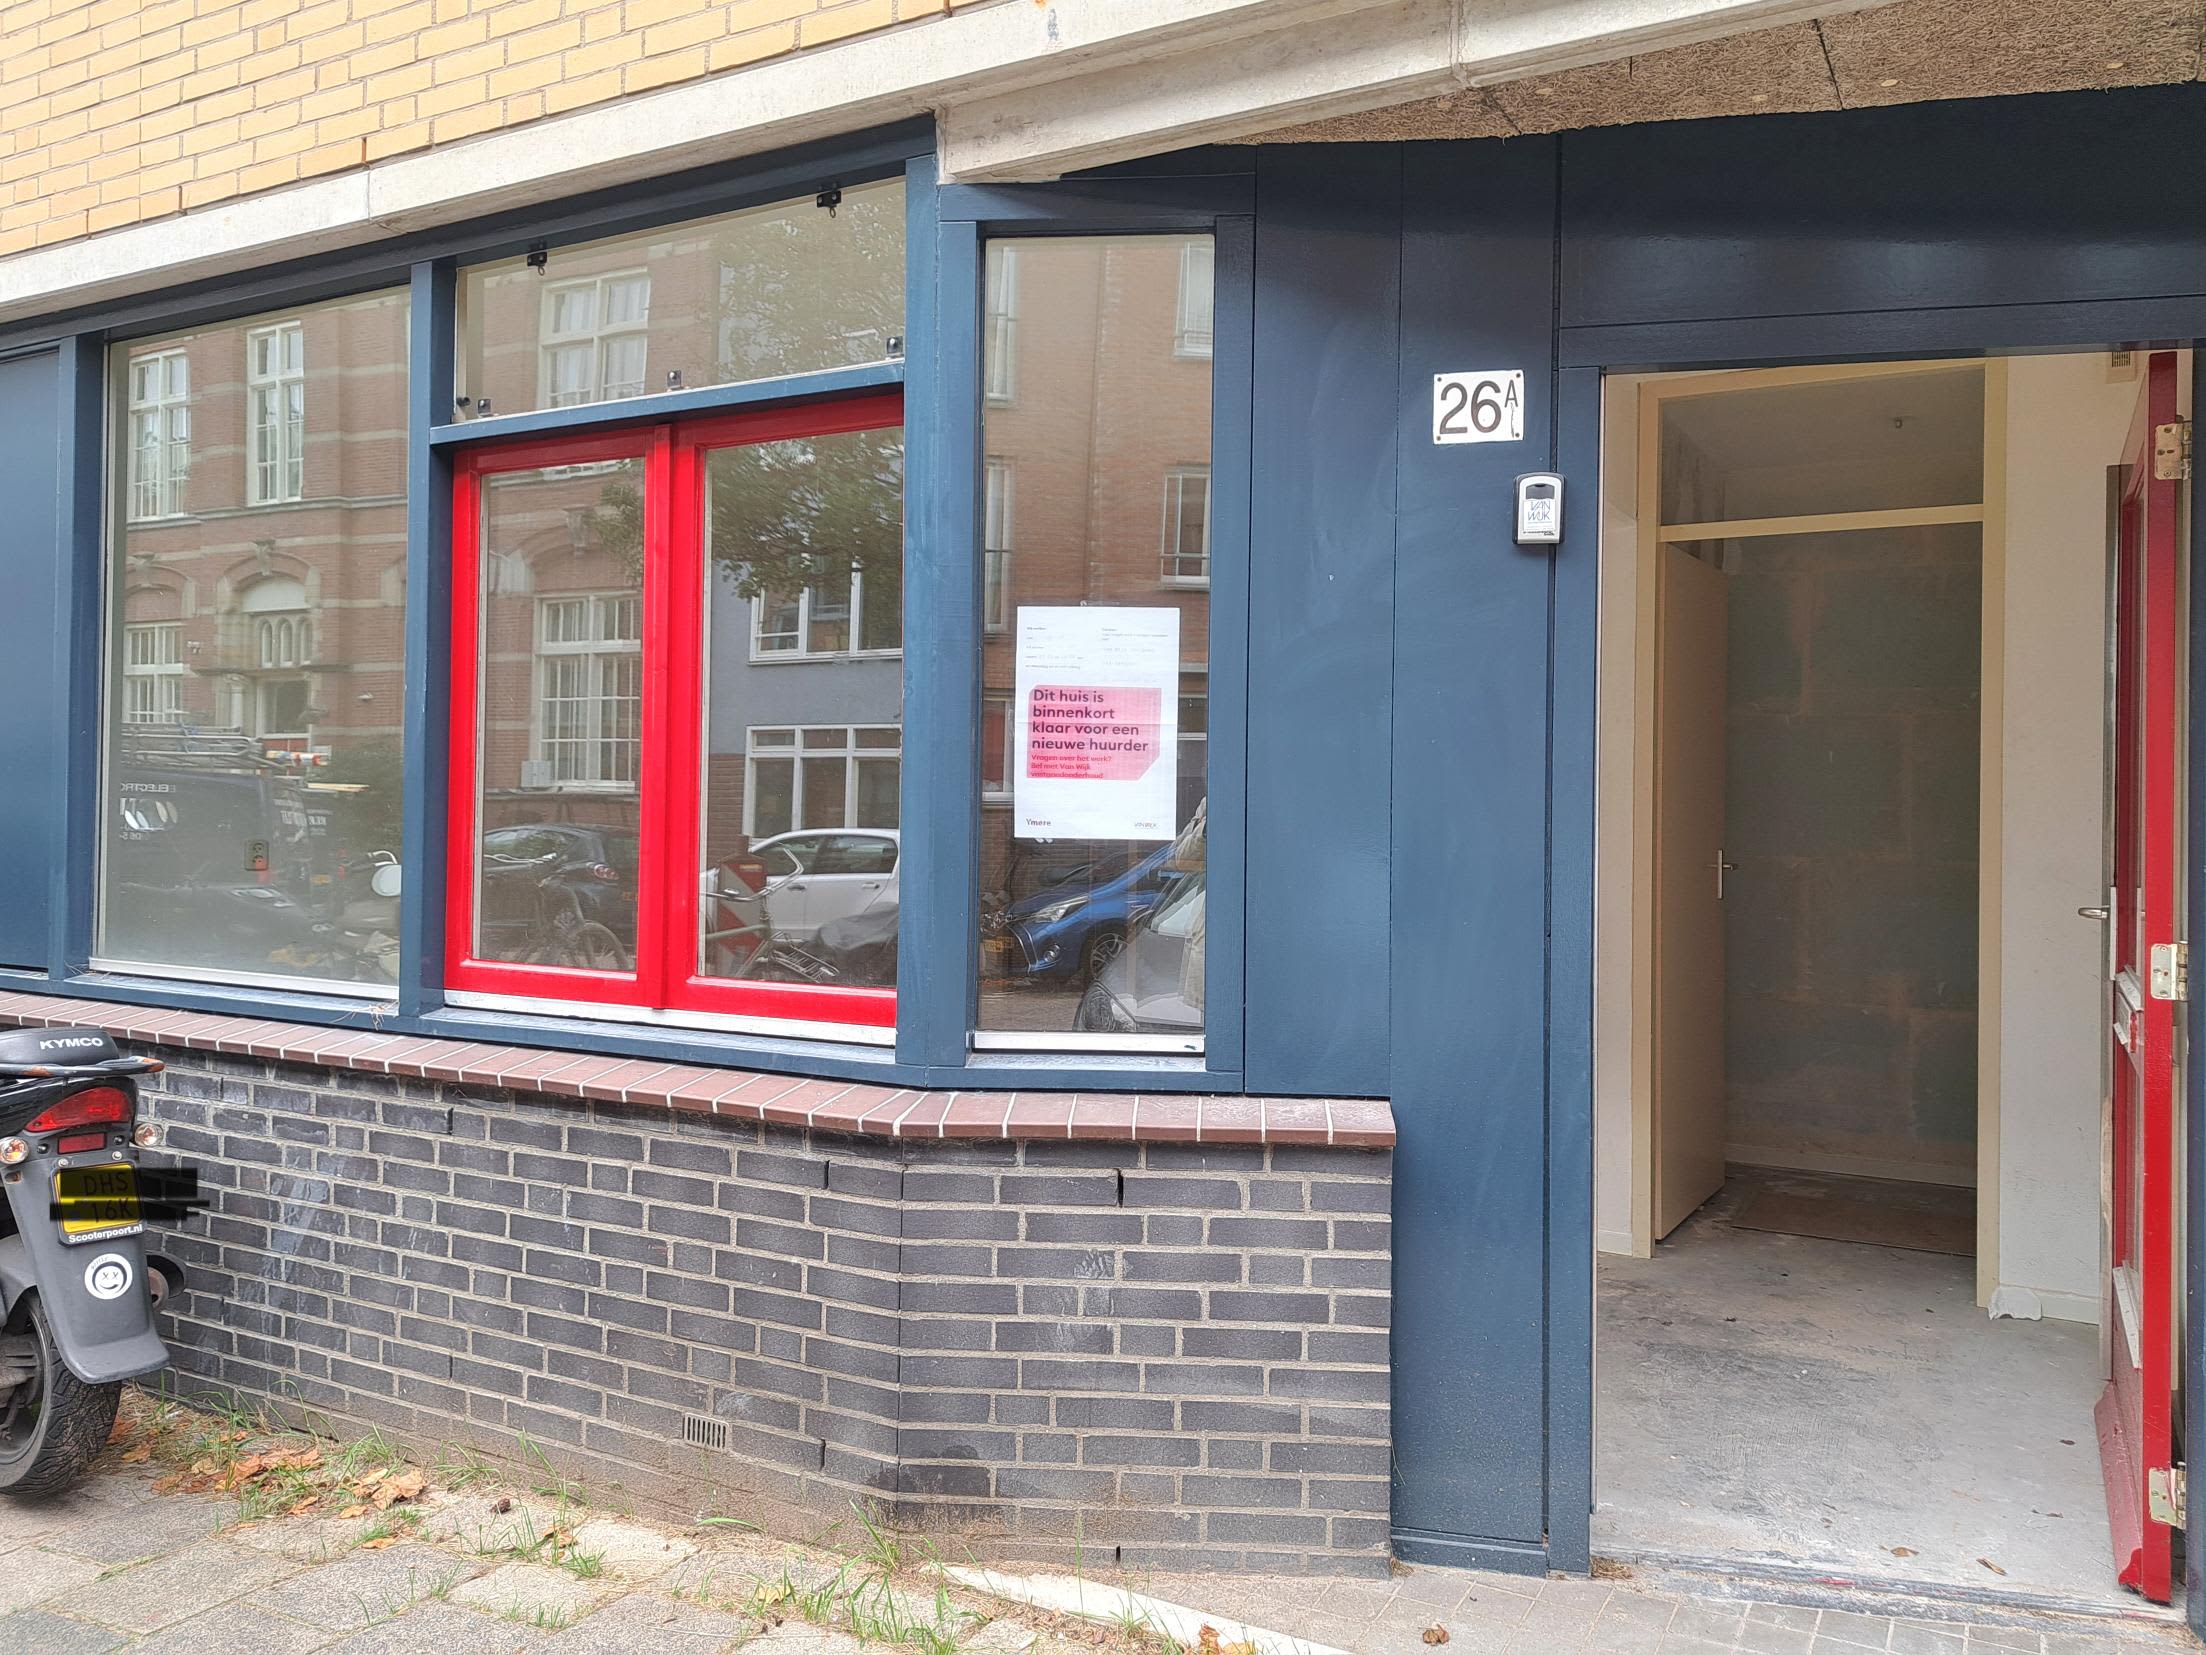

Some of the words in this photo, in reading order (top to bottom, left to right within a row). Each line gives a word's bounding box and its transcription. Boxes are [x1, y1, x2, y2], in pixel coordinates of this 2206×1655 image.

[1530, 500, 1551, 511] VAN
[1033, 689, 1055, 702] Dit
[1059, 690, 1089, 703] huis
[1093, 691, 1104, 703] is
[1032, 705, 1115, 719] binnenkort
[1032, 721, 1070, 734] klaar
[1075, 724, 1108, 735] voor
[1112, 725, 1139, 736] een
[1031, 737, 1085, 750] nieuwe
[1089, 738, 1148, 752] huurder
[1031, 754, 1058, 762] Vragen
[1075, 763, 1091, 771] Wijk
[1026, 818, 1052, 827] Ymere
[39, 1037, 104, 1050] KYMCO
[68, 1224, 143, 1243] Scooterpoort.nl
